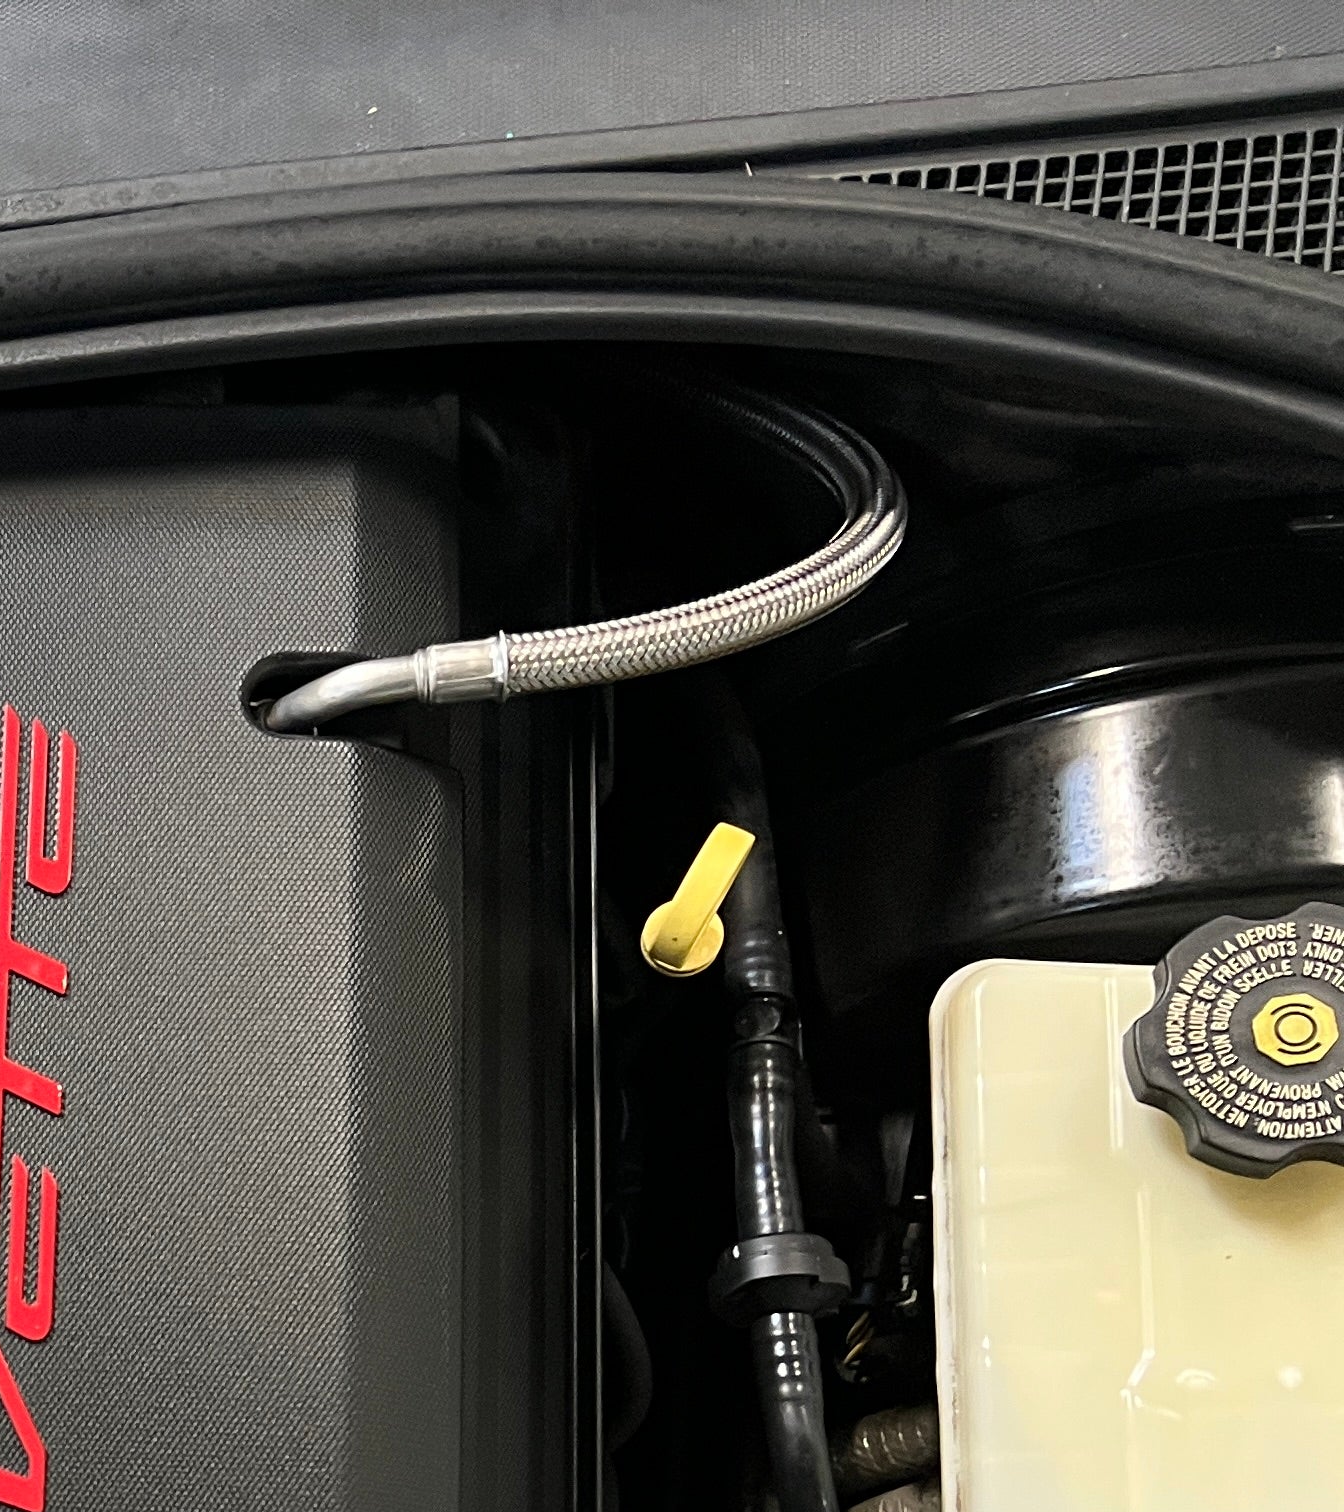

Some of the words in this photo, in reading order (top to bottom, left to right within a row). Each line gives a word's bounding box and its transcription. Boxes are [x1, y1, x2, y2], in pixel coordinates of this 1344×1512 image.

[1213, 940, 1239, 960] LA
[1236, 922, 1296, 948] DEPOSE
[1256, 941, 1297, 962] DOT3
[1213, 950, 1257, 984] FREIN
[1302, 941, 1344, 963] ONLY
[1179, 953, 1217, 994] AVANT
[1233, 960, 1294, 993] SCELLE
[1167, 993, 1191, 1056] BOUCHON
[1188, 999, 1212, 1053] LIQUIDE
[1210, 988, 1241, 1031] BIDON
[1173, 1057, 1194, 1076] LE
[1229, 1065, 1322, 1100] PROVENANT
[1184, 1074, 1250, 1127] NETTOYER
[1207, 1070, 1238, 1098] QUE
